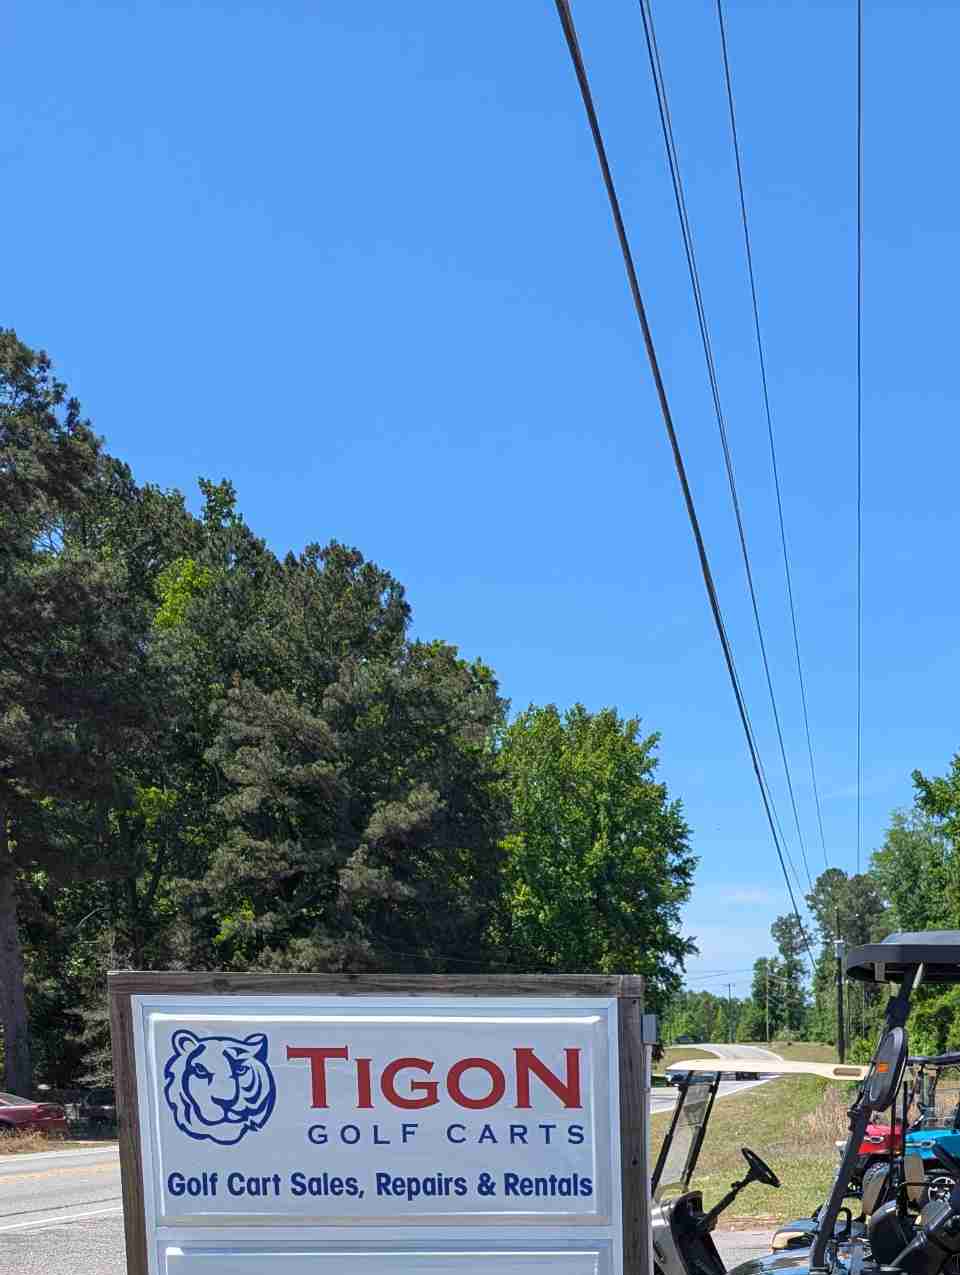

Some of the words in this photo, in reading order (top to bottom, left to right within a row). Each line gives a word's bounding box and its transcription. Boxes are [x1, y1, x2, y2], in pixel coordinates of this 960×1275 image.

[285, 1045, 583, 1110] TIGON
[307, 1123, 419, 1145] GOLF
[446, 1123, 586, 1145] CARTS
[167, 1171, 219, 1197] Golf
[226, 1172, 281, 1197] Cart
[290, 1171, 365, 1199] Sales,
[375, 1172, 468, 1202] Repairs
[477, 1172, 497, 1197] &
[503, 1172, 593, 1197] Rentals
